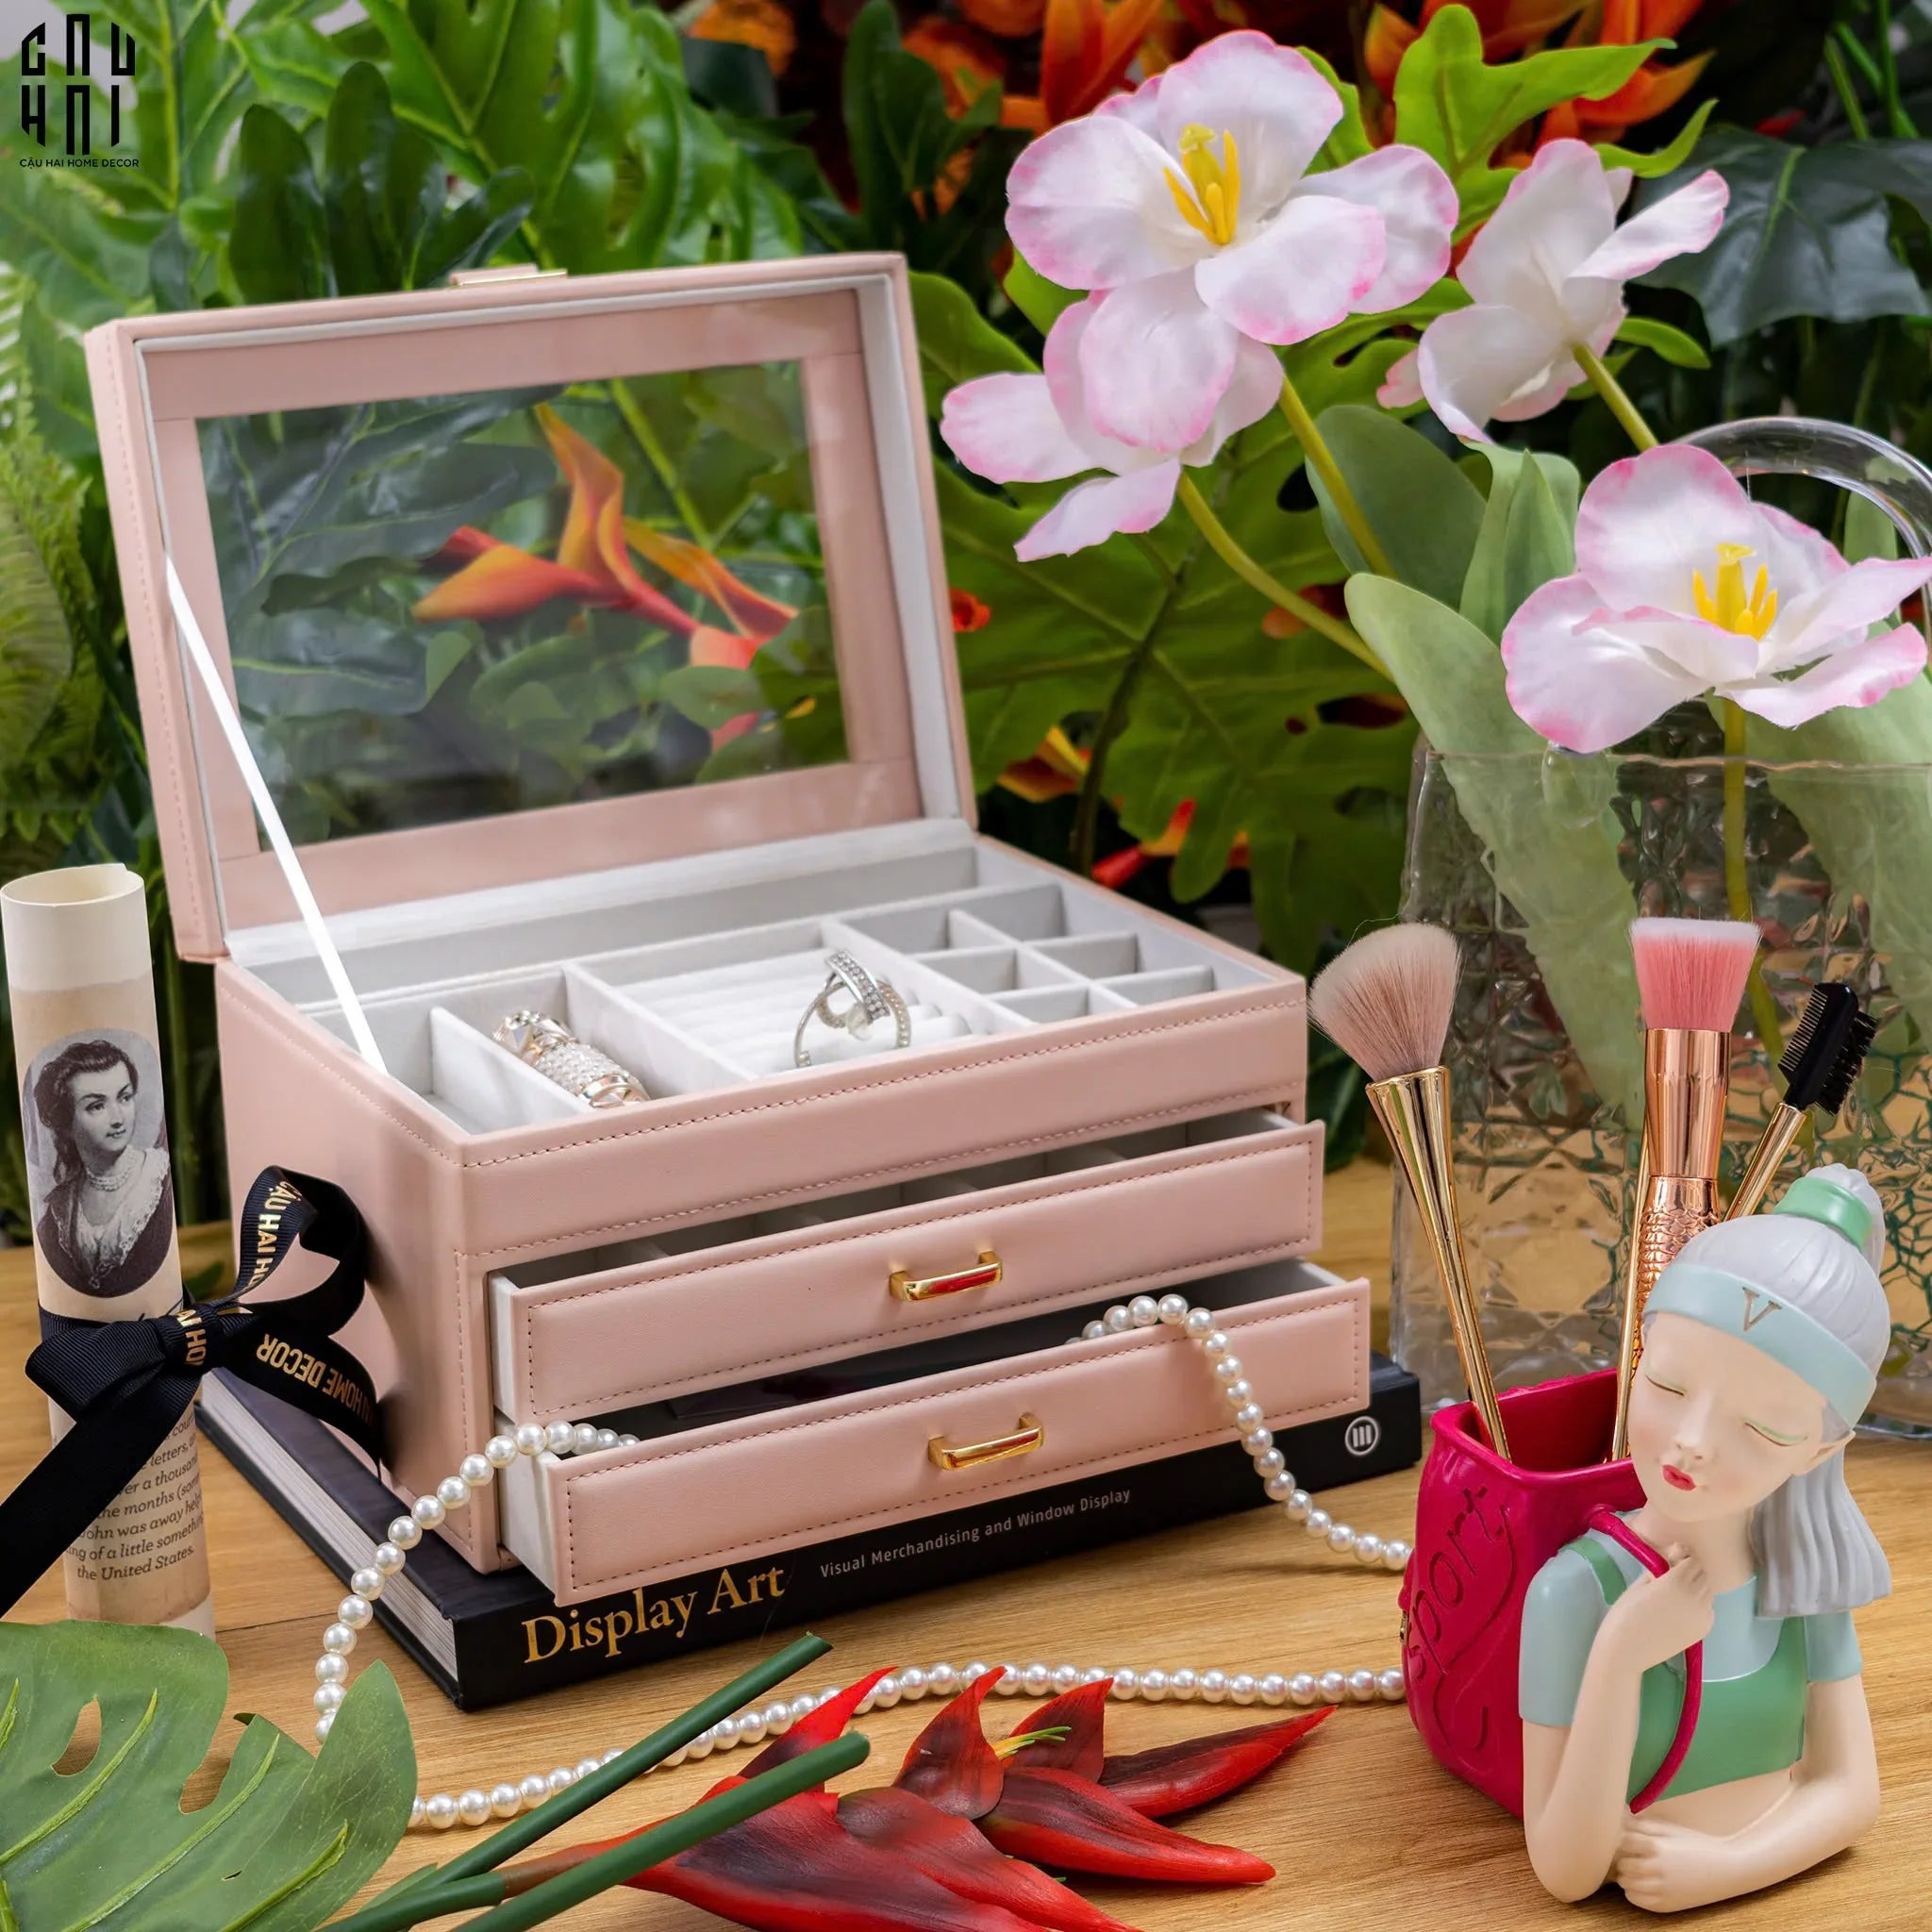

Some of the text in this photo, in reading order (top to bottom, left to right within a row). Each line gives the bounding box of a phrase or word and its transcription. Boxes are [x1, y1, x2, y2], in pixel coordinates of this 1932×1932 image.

[258, 1213, 282, 1254] HAI
[256, 1333, 327, 1389] DECOR
[322, 1368, 364, 1415] HOME
[142, 1478, 152, 1491] a
[124, 1491, 175, 1516] months
[117, 1523, 147, 1538] was
[149, 1507, 184, 1531] away
[820, 1488, 1131, 1578] Visual Merchandising and Window Display
[89, 1546, 106, 1561] of
[107, 1548, 116, 1559] a
[120, 1540, 155, 1558] little
[77, 1565, 97, 1580] the
[101, 1558, 152, 1581] United
[522, 1566, 786, 1663] Display Art
